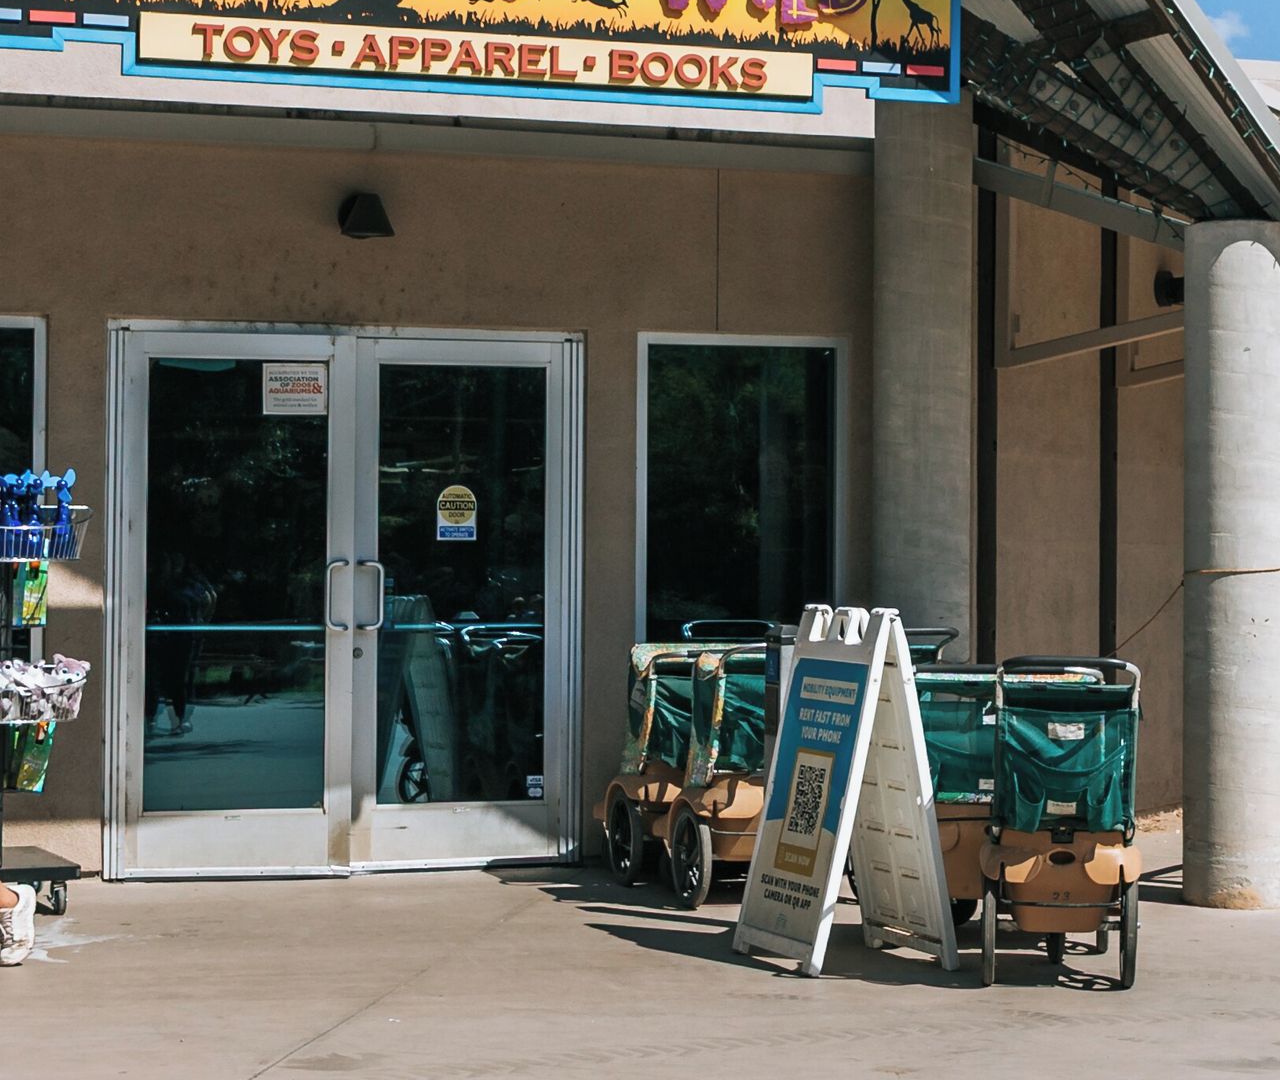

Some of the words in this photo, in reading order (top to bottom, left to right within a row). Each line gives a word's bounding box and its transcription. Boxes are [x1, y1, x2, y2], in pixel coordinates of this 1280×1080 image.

[193, 23, 321, 63] TOYS
[353, 33, 578, 81] APPAREL
[607, 48, 768, 91] BOOKS
[439, 501, 475, 509] CAUTION
[803, 682, 826, 694] MOBILITY
[825, 686, 856, 699] EQUIPMENT
[799, 707, 815, 721] RENT
[815, 709, 832, 724] FAST
[832, 712, 852, 728] FROM
[802, 725, 817, 740] YOUR
[817, 728, 842, 744] PHONE
[761, 873, 775, 886] SCAN
[774, 876, 788, 890] WITH
[787, 880, 802, 893] YOUR
[801, 884, 820, 898] PHONE
[764, 888, 784, 903] CAMERA
[784, 893, 792, 905] OR
[791, 896, 800, 910] QR
[800, 898, 811, 910] APP
